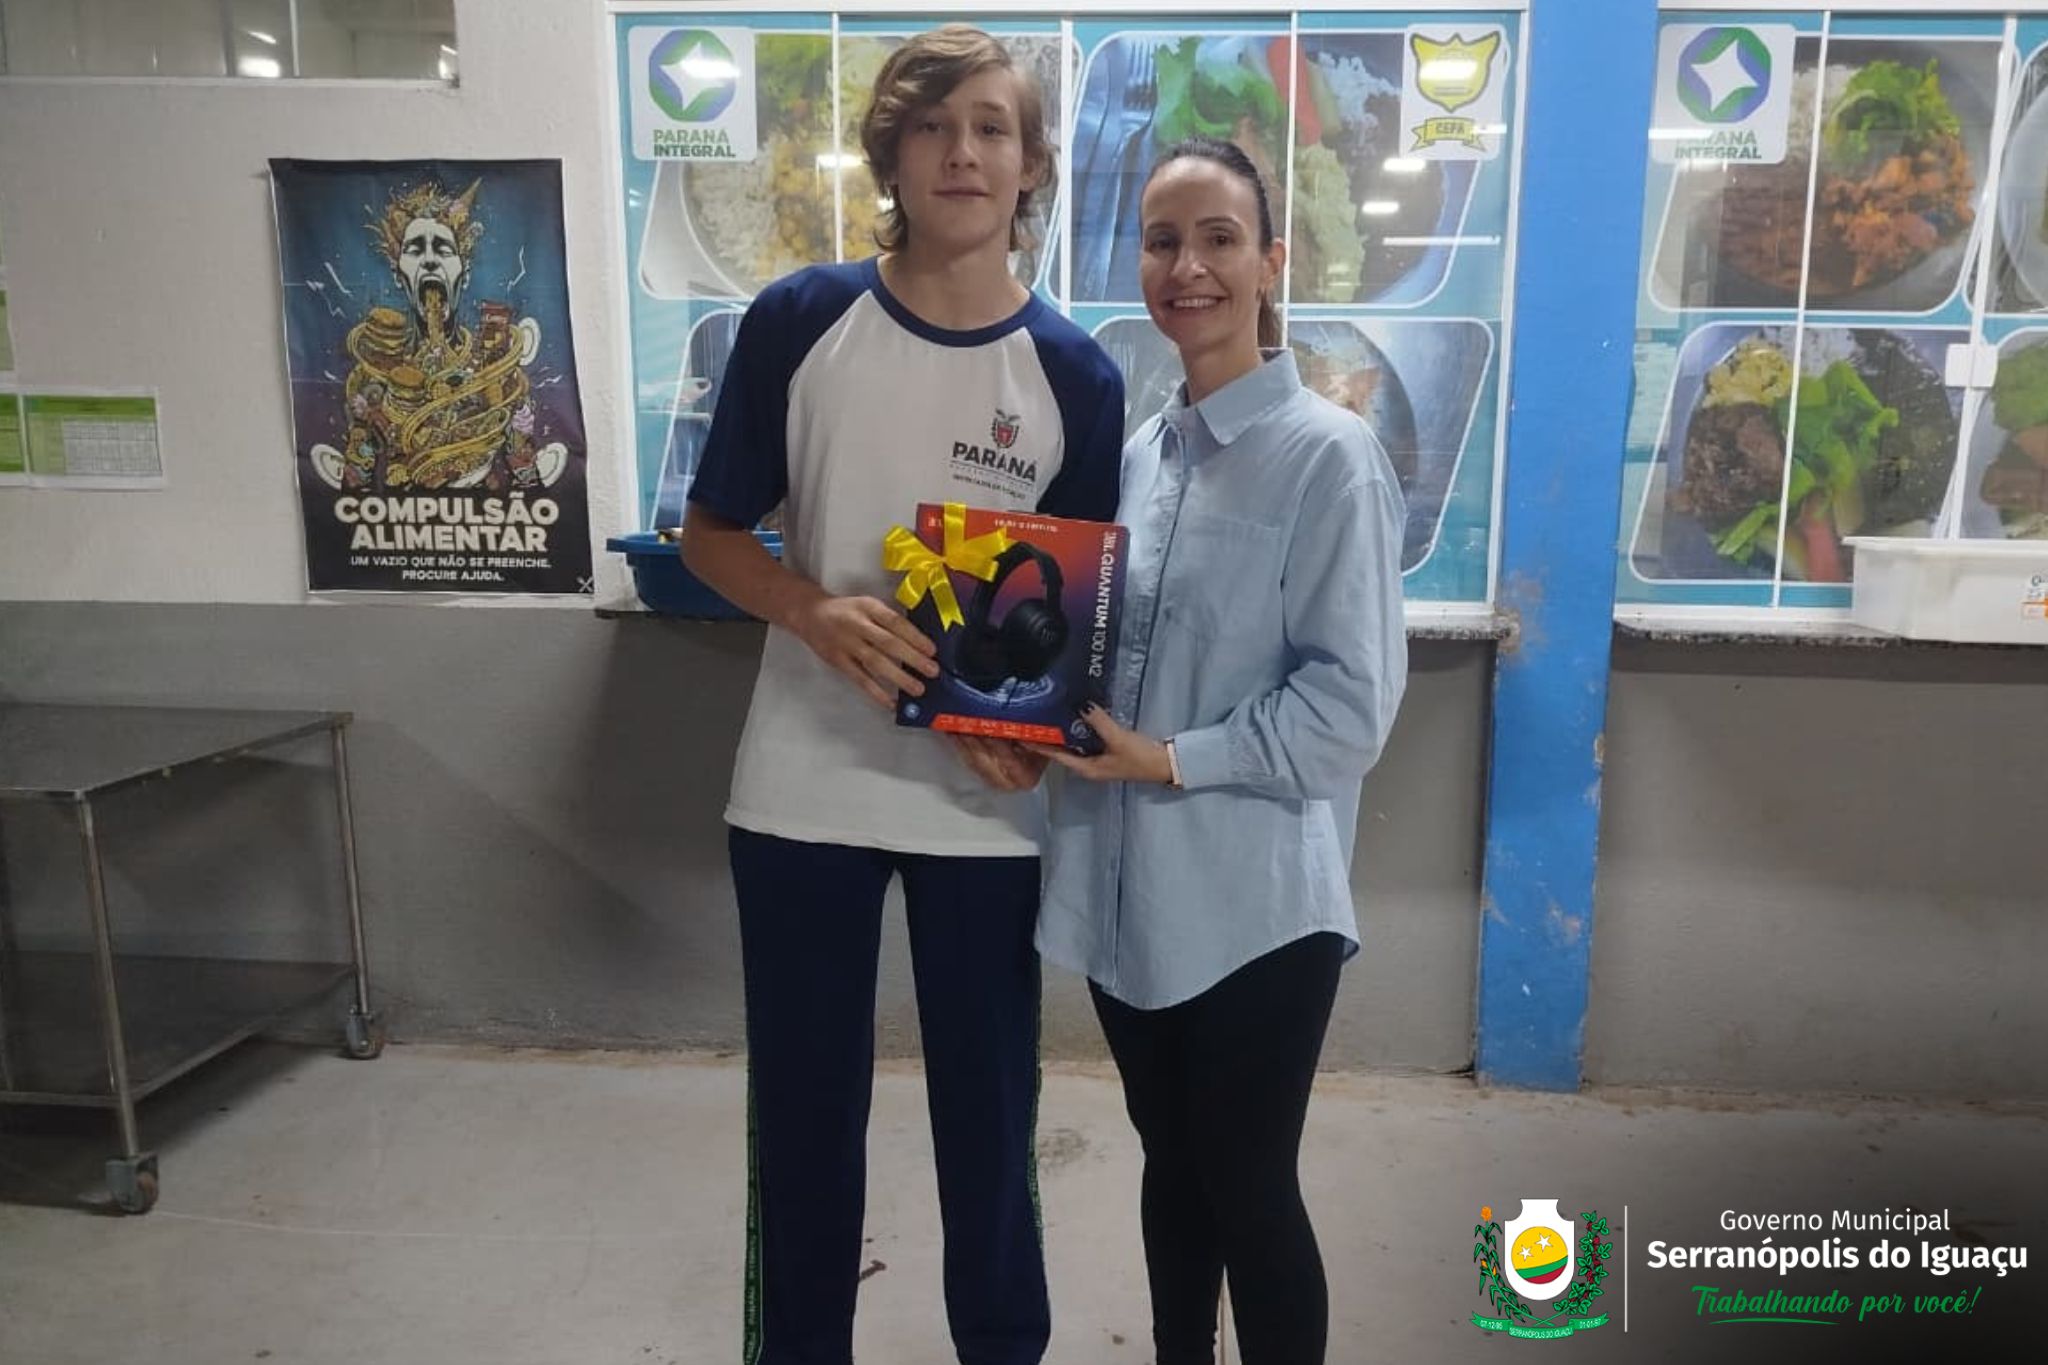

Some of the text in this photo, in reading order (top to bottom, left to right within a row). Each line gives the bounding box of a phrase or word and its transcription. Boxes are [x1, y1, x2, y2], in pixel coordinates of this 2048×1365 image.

[653, 144, 737, 158] INTEGRAL
[1675, 146, 1762, 159] INTEGRAL
[334, 491, 560, 526] COMPULSÃO
[351, 523, 548, 552] ALIMENTAR
[351, 555, 369, 566] UM
[373, 555, 408, 567] VAZIO
[411, 556, 435, 568] QUE
[438, 553, 466, 568] NÃO
[469, 557, 486, 568] SE
[402, 569, 505, 582] PROCURE AJUDA.
[1094, 553, 1115, 628] QUANTUM
[1088, 653, 1104, 678] M2
